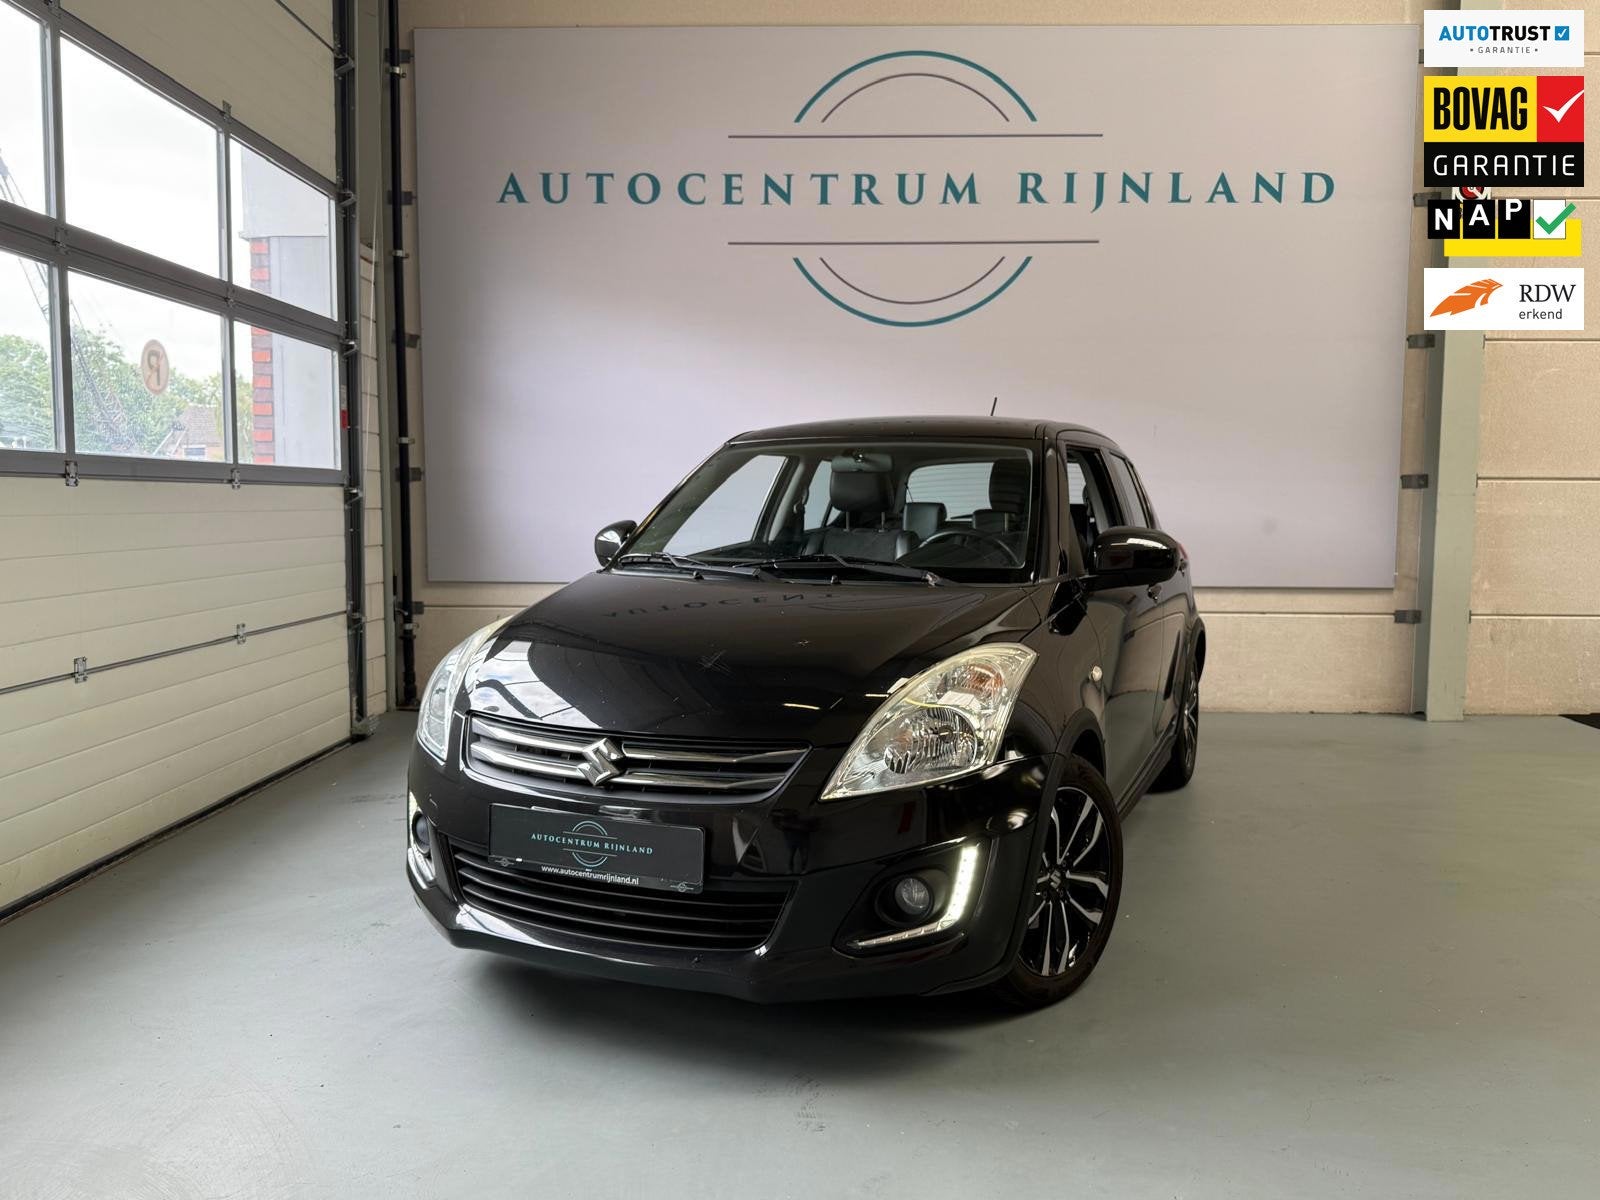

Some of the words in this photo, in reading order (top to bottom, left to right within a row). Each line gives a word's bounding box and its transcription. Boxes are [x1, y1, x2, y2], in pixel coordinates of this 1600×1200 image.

[497, 170, 979, 206] AUTOCENTRUM
[1018, 170, 1337, 213] RIJNLAND
[531, 833, 600, 849] AUTOCENTRUM
[604, 842, 653, 855] RIJNLAND
[541, 865, 639, 886] www.autocentrumrijnland.nl
